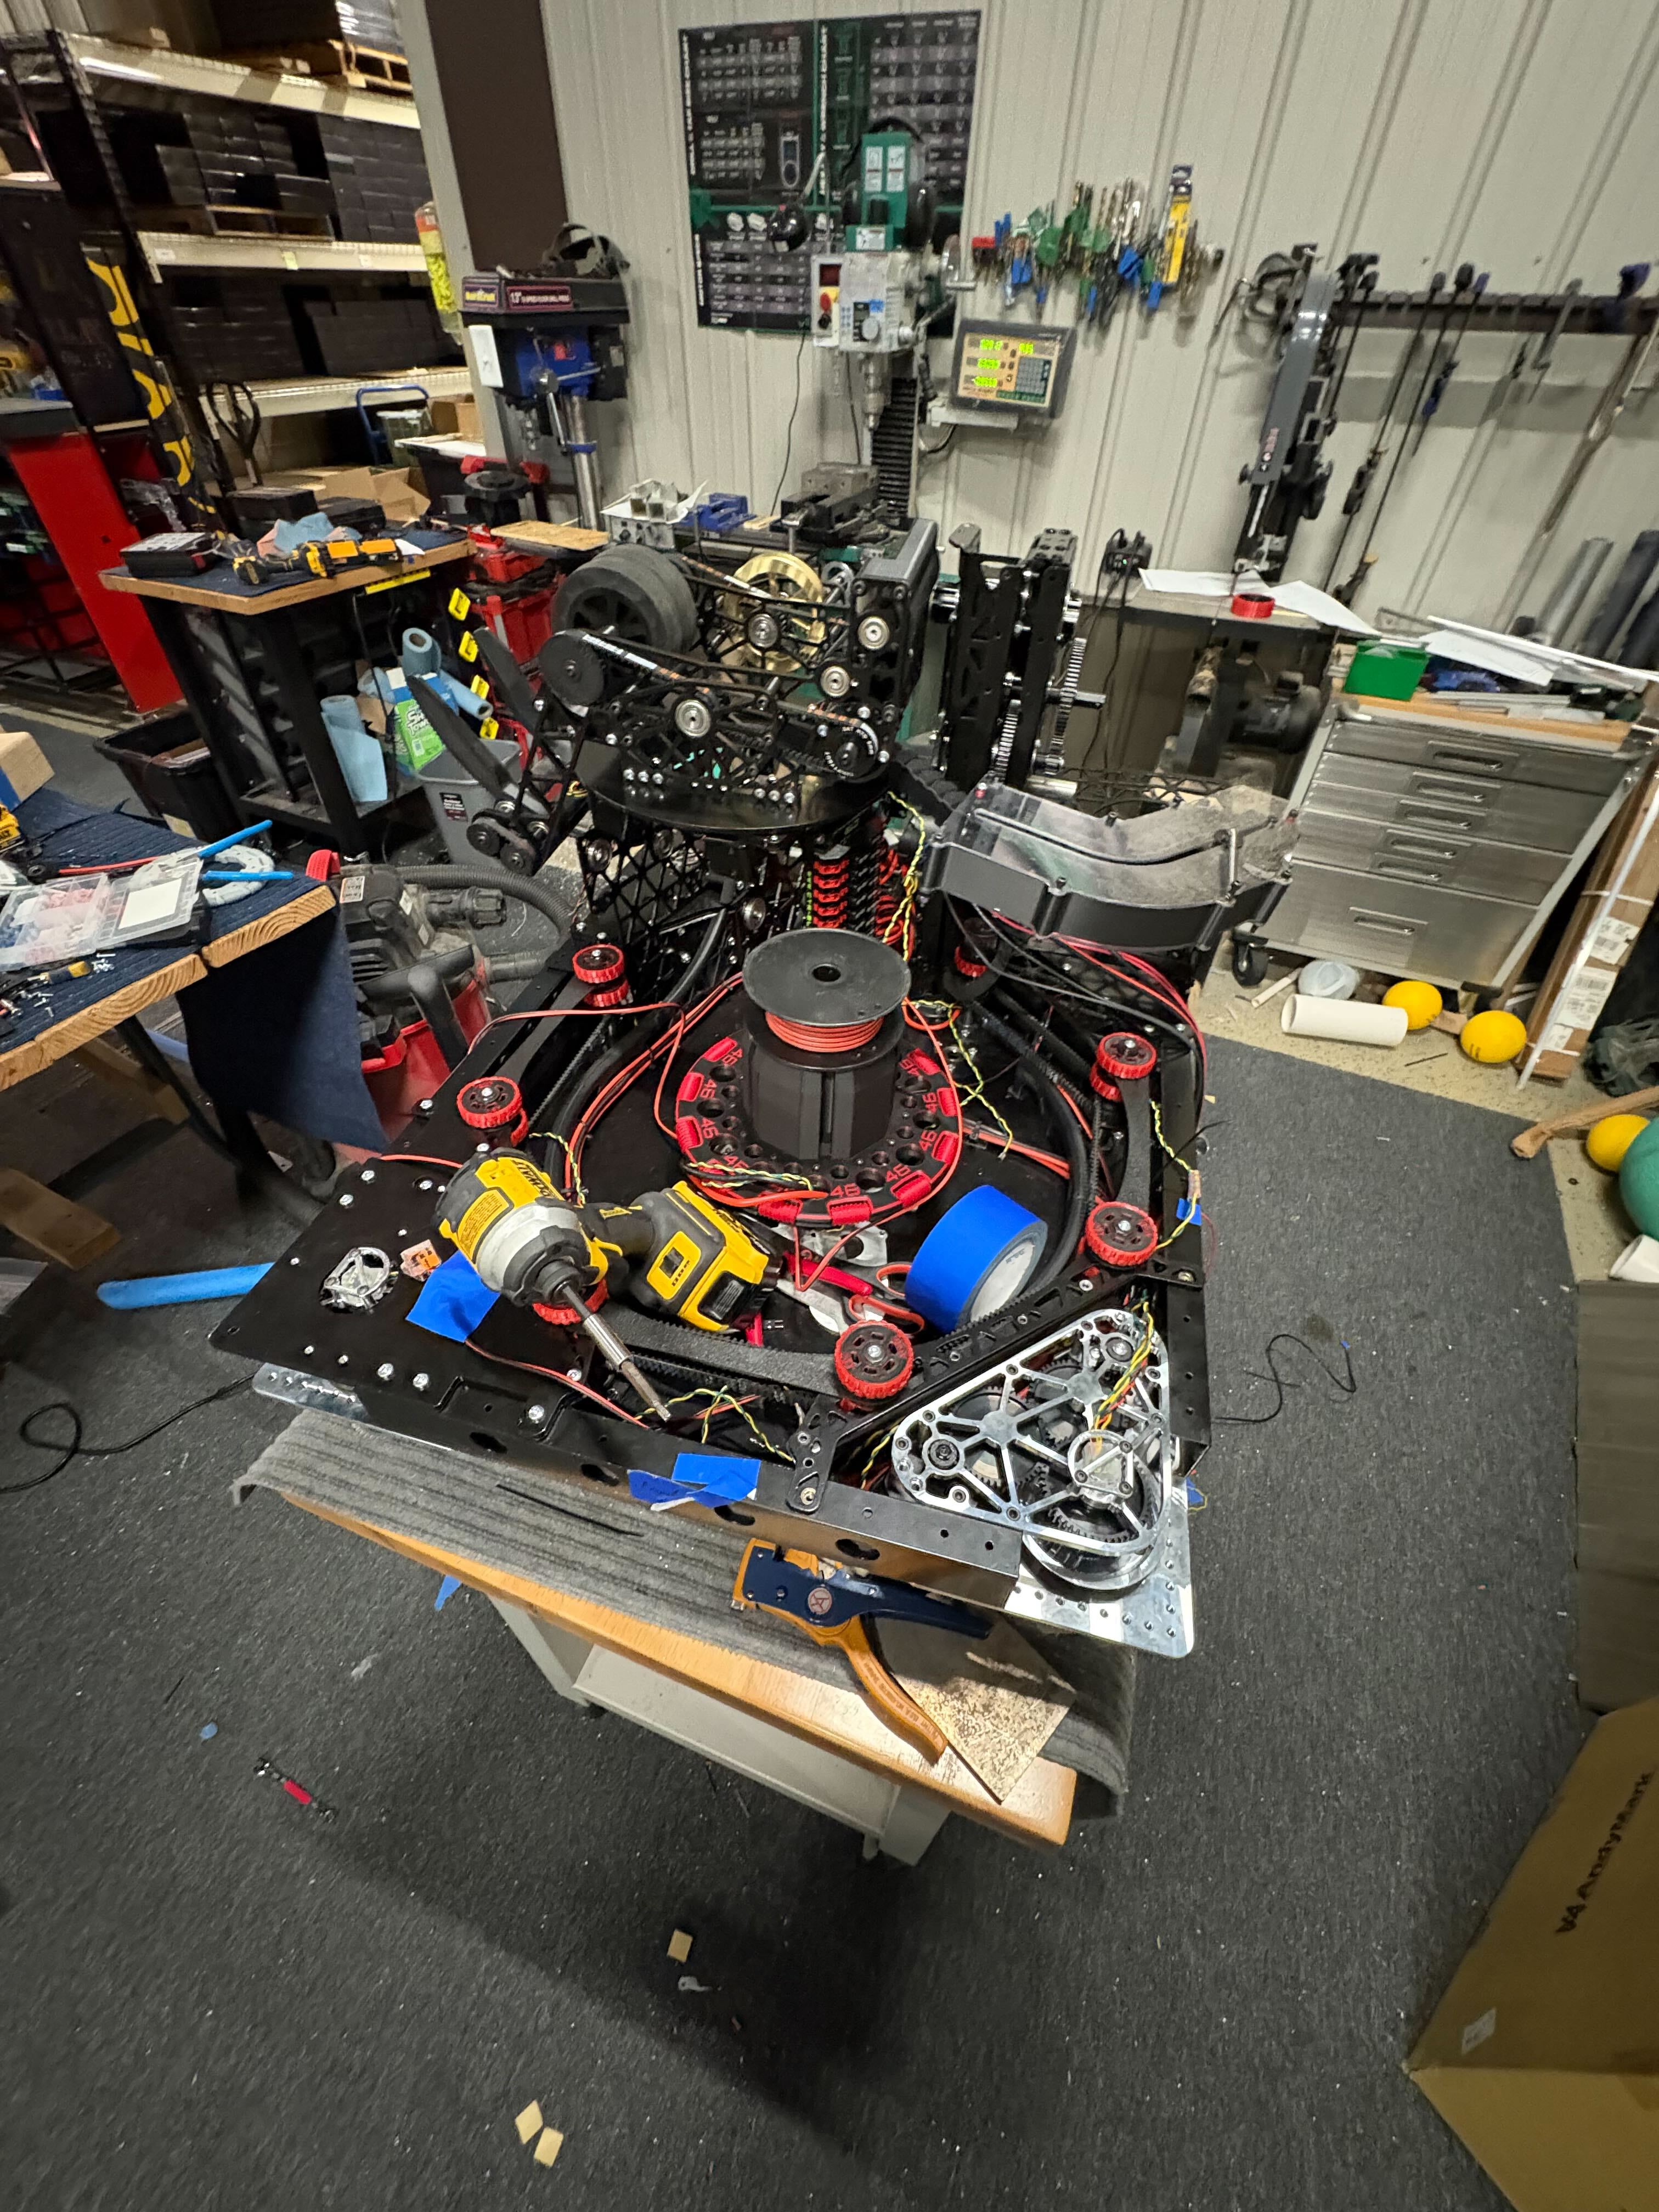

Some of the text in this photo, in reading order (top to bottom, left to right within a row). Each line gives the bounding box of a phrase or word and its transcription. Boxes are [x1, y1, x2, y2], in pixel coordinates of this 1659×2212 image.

[700, 1079, 718, 1099] 46
[922, 1092, 939, 1114] 46
[701, 1116, 720, 1139] 46
[918, 1130, 938, 1152] 46
[885, 1163, 912, 1182] 46
[830, 1182, 861, 1197] 46
